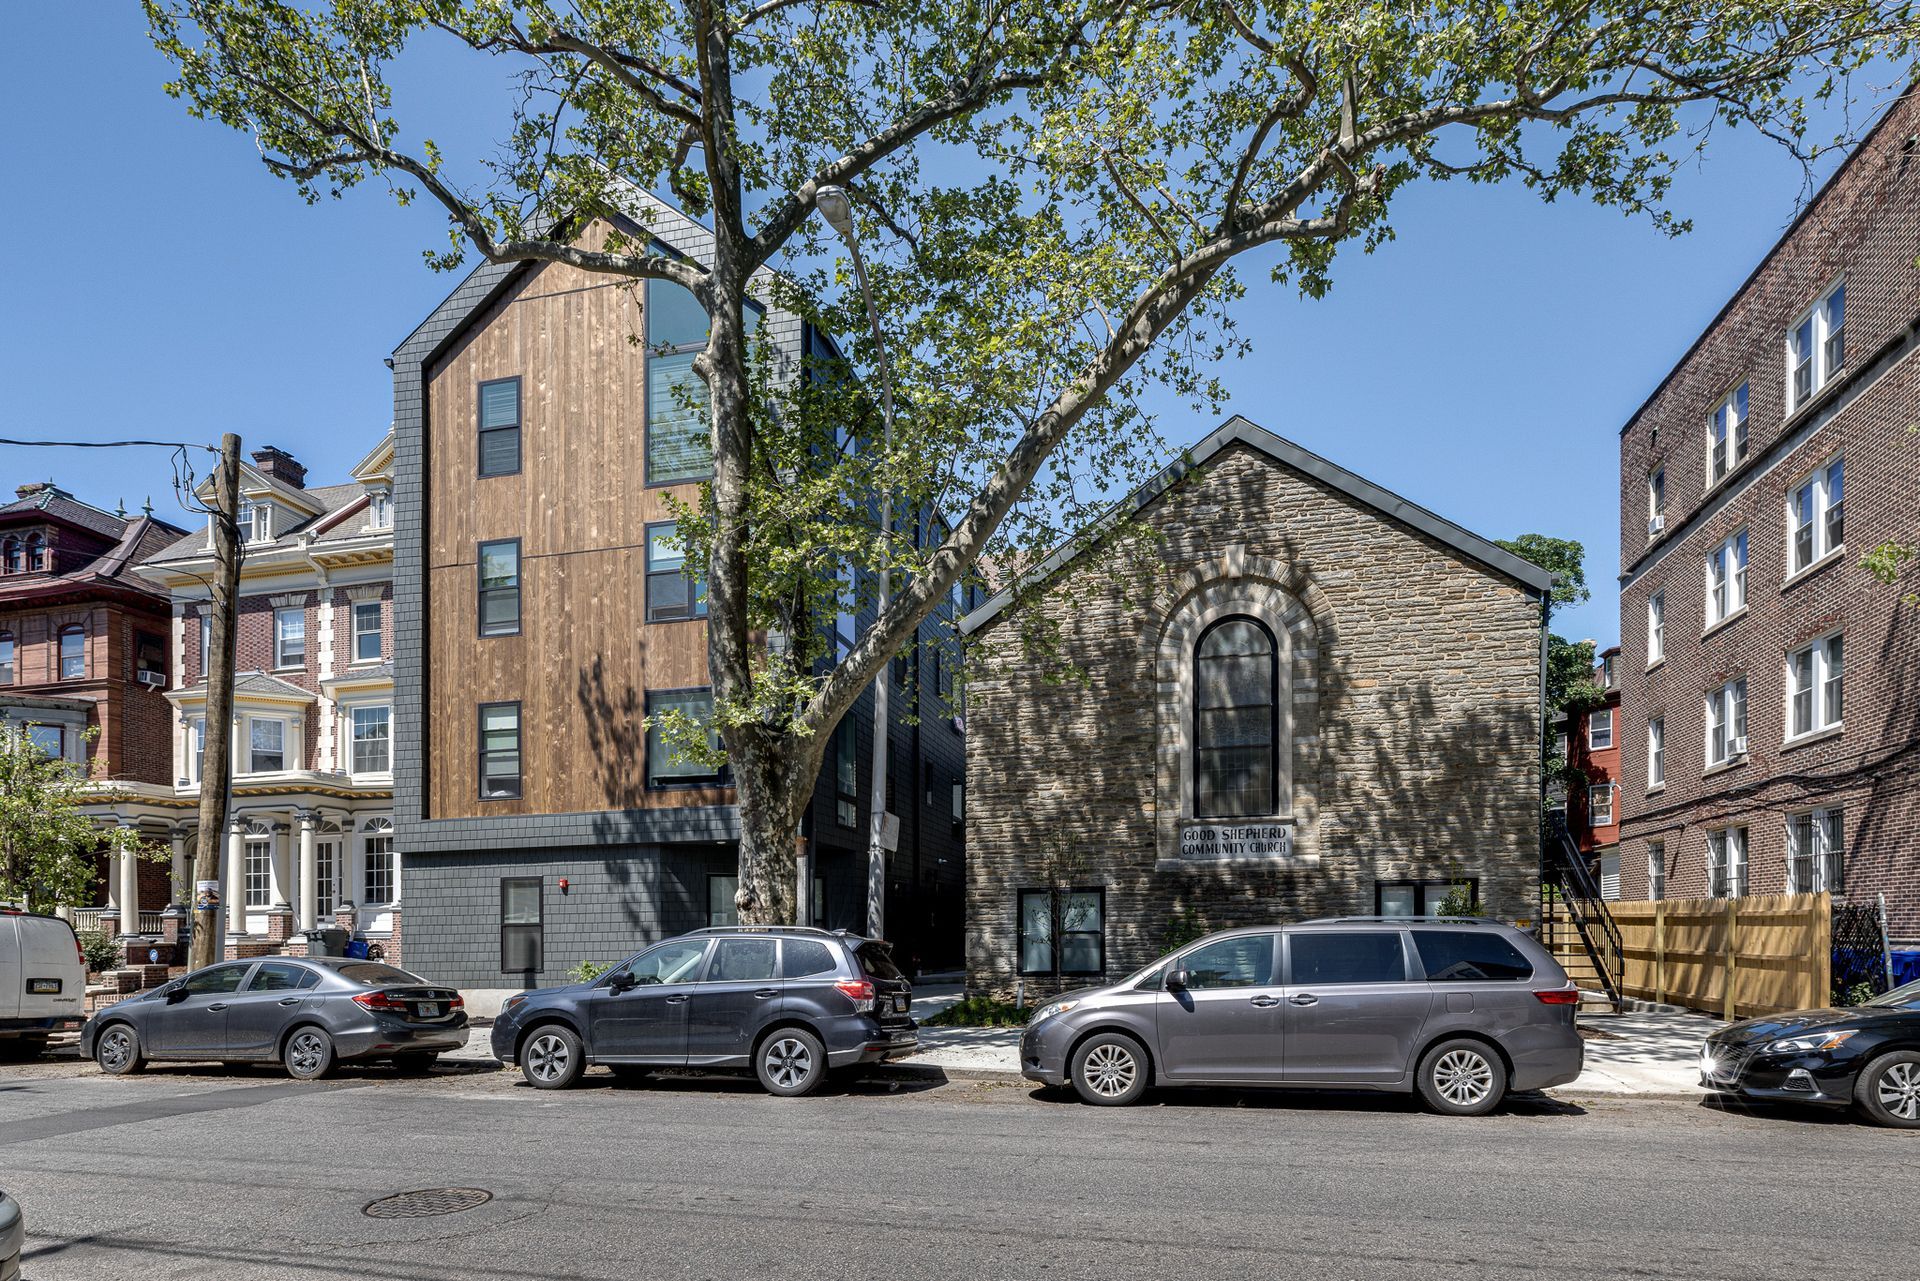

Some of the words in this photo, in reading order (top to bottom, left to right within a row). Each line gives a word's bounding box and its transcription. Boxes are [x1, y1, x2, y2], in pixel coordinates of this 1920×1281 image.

[1184, 830, 1215, 841] GOOD
[1221, 828, 1286, 840] SHEPHERD
[1182, 843, 1246, 855] COMMUNITY
[1249, 842, 1286, 853] CHURCH
